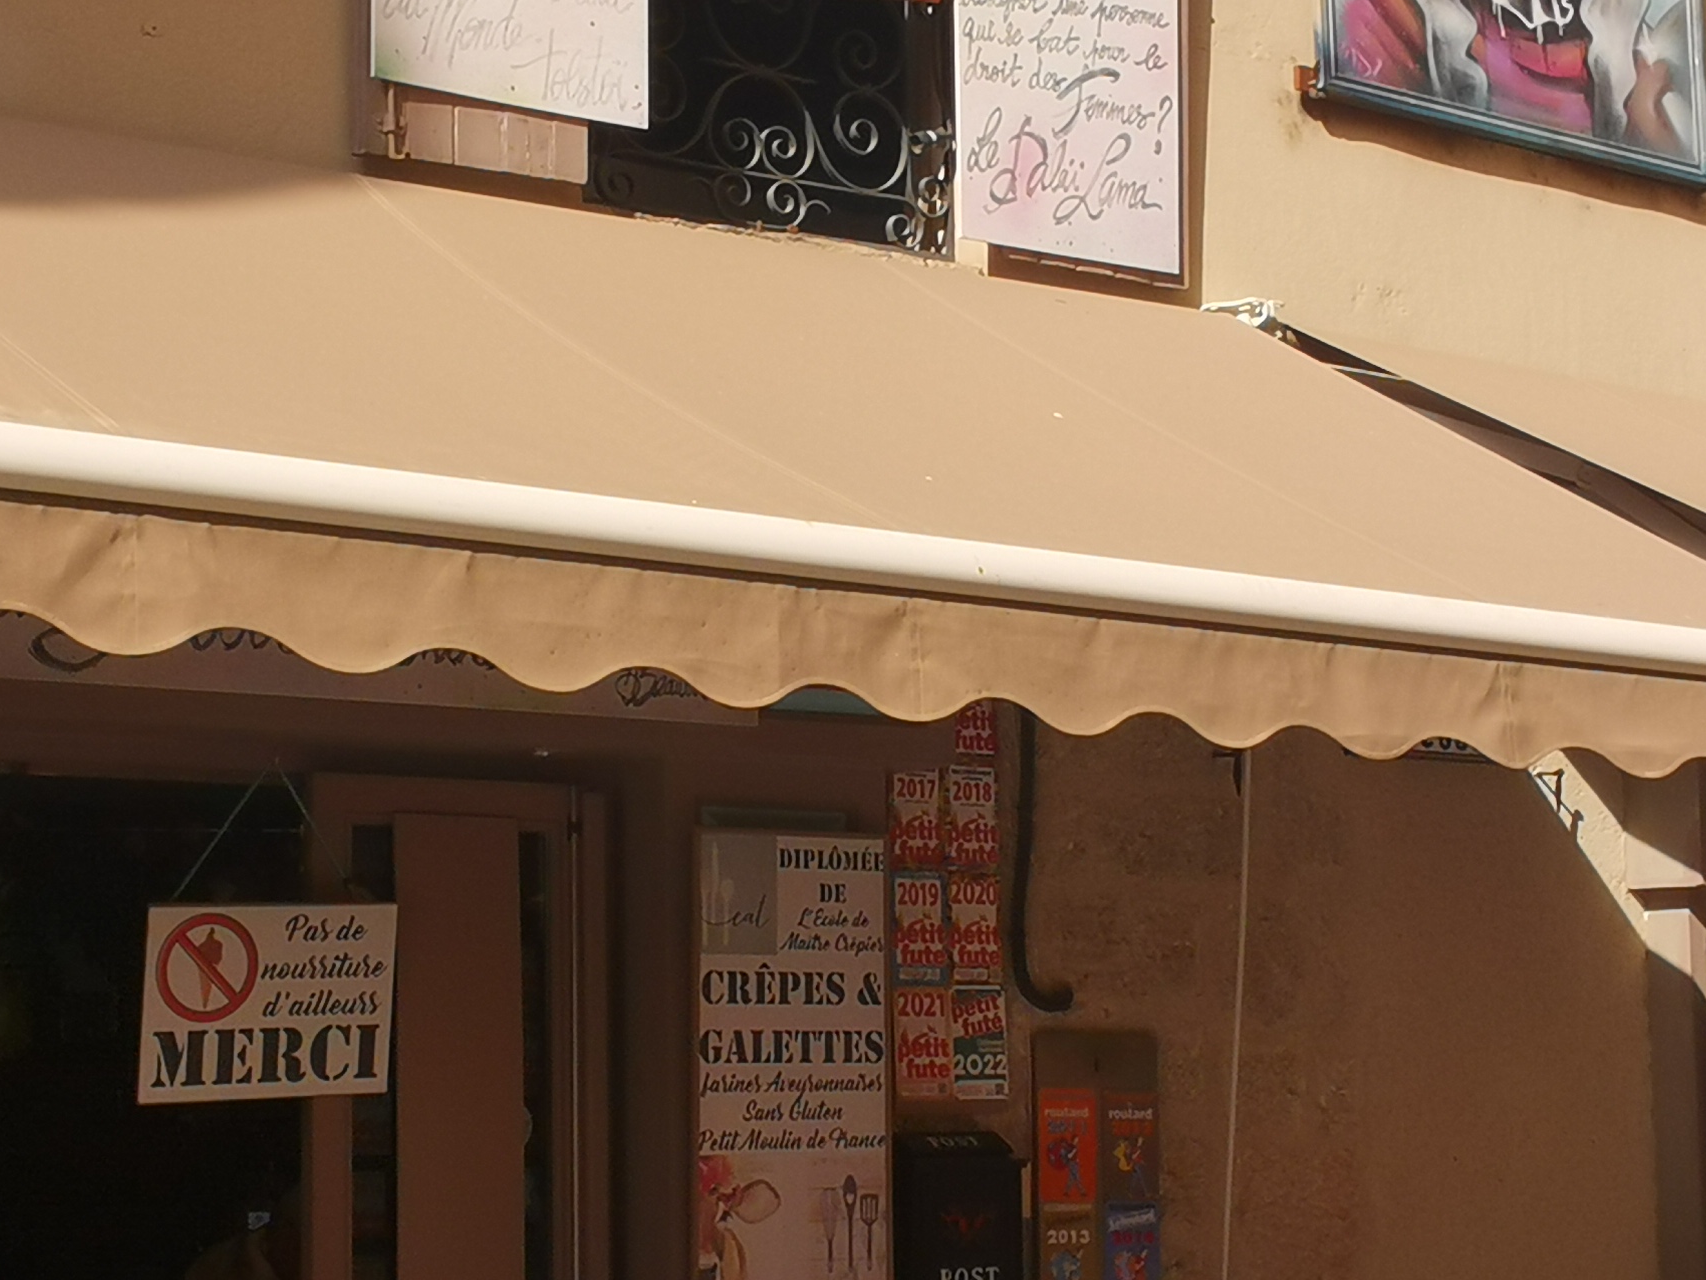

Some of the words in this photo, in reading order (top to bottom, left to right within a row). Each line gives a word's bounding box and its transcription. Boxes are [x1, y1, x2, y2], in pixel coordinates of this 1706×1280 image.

[895, 777, 936, 799] 2017
[953, 781, 992, 802] 2018
[819, 883, 848, 903] DE
[896, 882, 940, 907] 2019
[950, 881, 998, 906] 2020
[285, 913, 334, 943] Pas
[335, 914, 369, 942] de
[851, 910, 870, 928] de
[260, 952, 388, 981] nourriture
[701, 962, 845, 1006] CRÊPES
[856, 971, 882, 1006] &
[262, 989, 383, 1018] d'ailleurs
[898, 992, 946, 1017] 2021
[150, 1024, 381, 1089] MERCI
[698, 1028, 884, 1065] GALETTES
[952, 1053, 1007, 1076] 2022
[762, 1070, 884, 1102] Aveyronnaises
[742, 1098, 785, 1123] Sans
[788, 1094, 844, 1123] Gluten
[698, 1128, 741, 1153] Petit
[738, 1127, 803, 1152] Moulin
[806, 1127, 827, 1150] de
[828, 1126, 886, 1150] France
[1046, 1229, 1091, 1245] 2013
